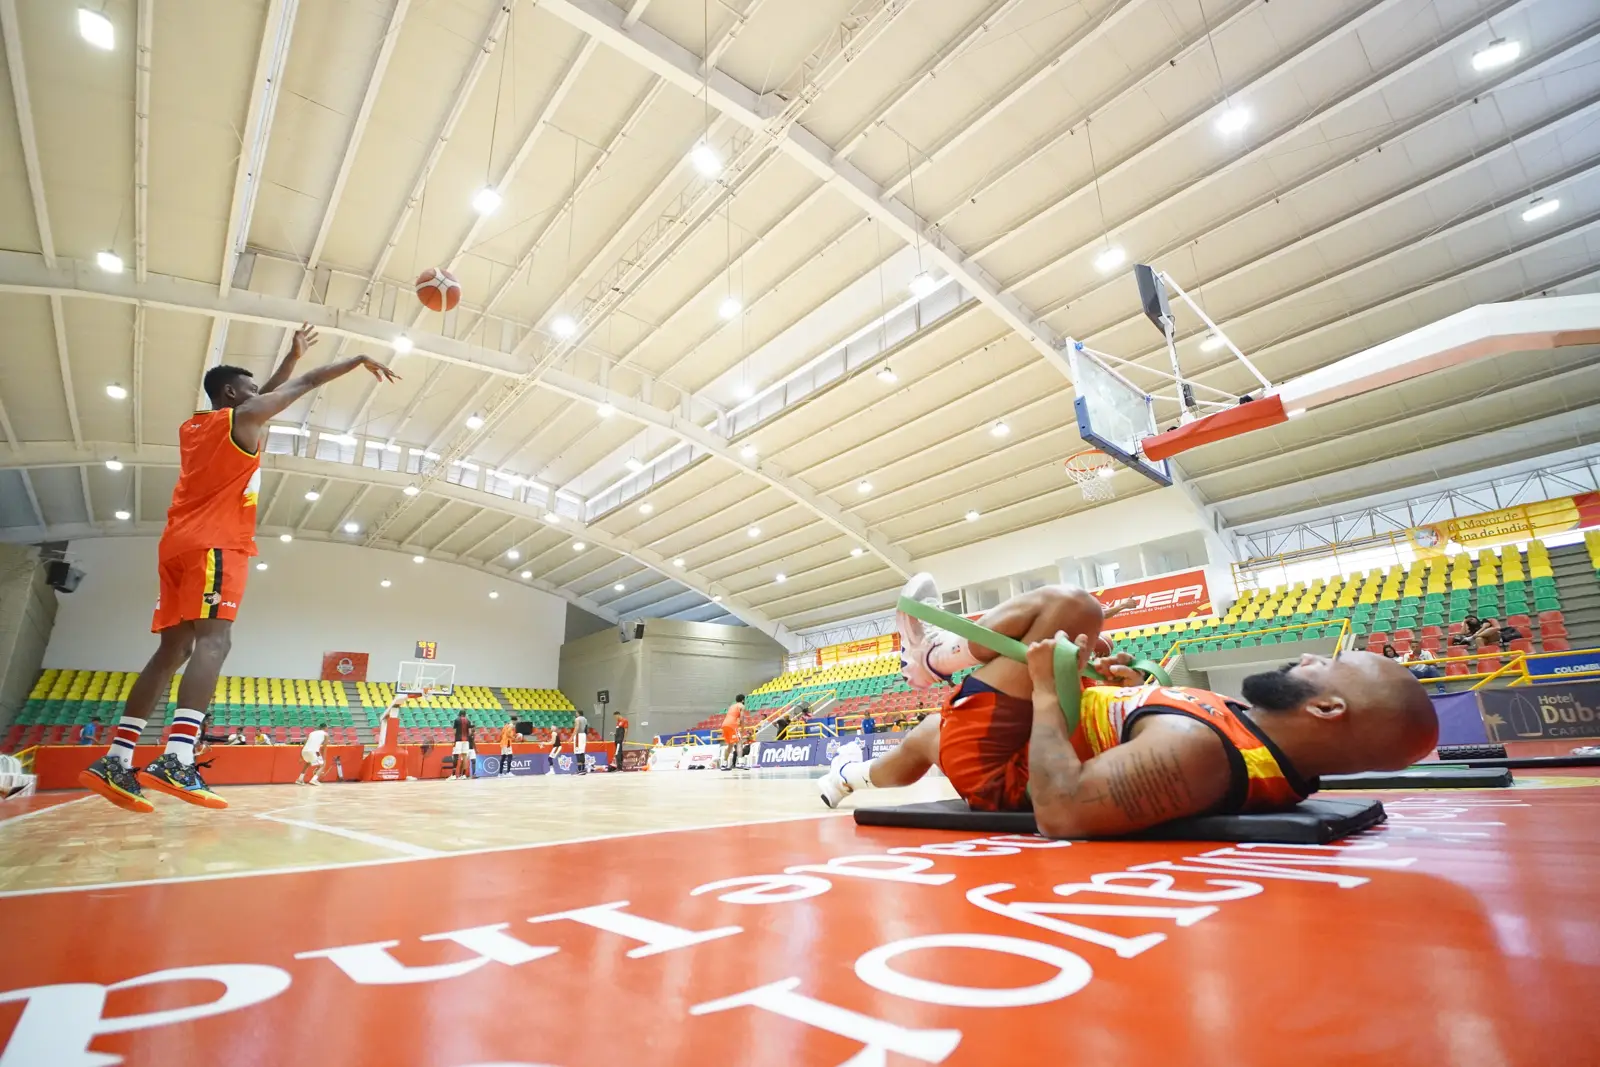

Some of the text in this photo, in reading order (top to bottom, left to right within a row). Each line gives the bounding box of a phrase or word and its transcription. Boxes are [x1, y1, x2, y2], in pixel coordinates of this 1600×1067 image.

[1463, 515, 1501, 529] Mayor
[1504, 512, 1518, 522] de
[1480, 528, 1495, 538] de
[221, 601, 237, 609] FILA
[1537, 692, 1575, 705] Hotel
[762, 744, 810, 763] molten
